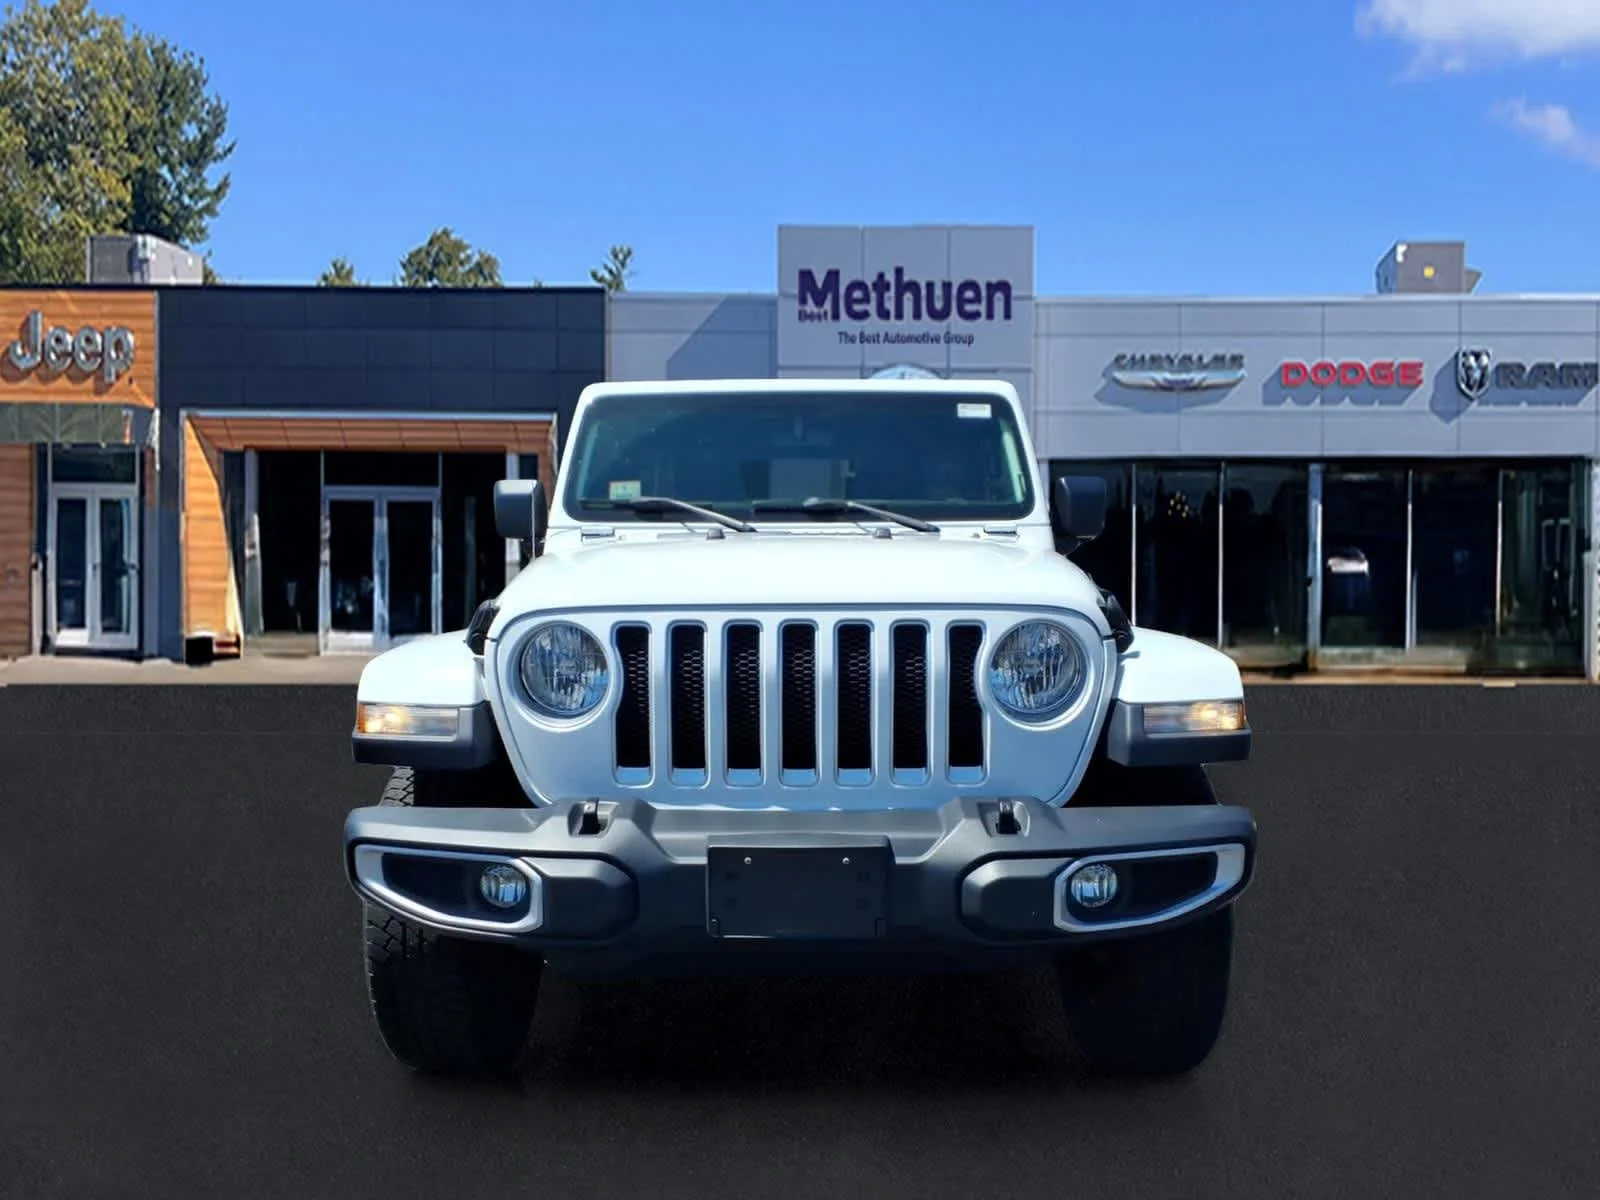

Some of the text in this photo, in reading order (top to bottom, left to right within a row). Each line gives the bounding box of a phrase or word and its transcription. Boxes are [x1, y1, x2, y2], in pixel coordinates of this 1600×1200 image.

[797, 266, 1013, 323] Methuen
[9, 310, 135, 384] Jeep
[838, 331, 974, 348] The Best Automotive Group
[1114, 353, 1245, 369] CHRYSLER
[1280, 361, 1423, 387] DODGE
[1496, 362, 1599, 389] RAM
